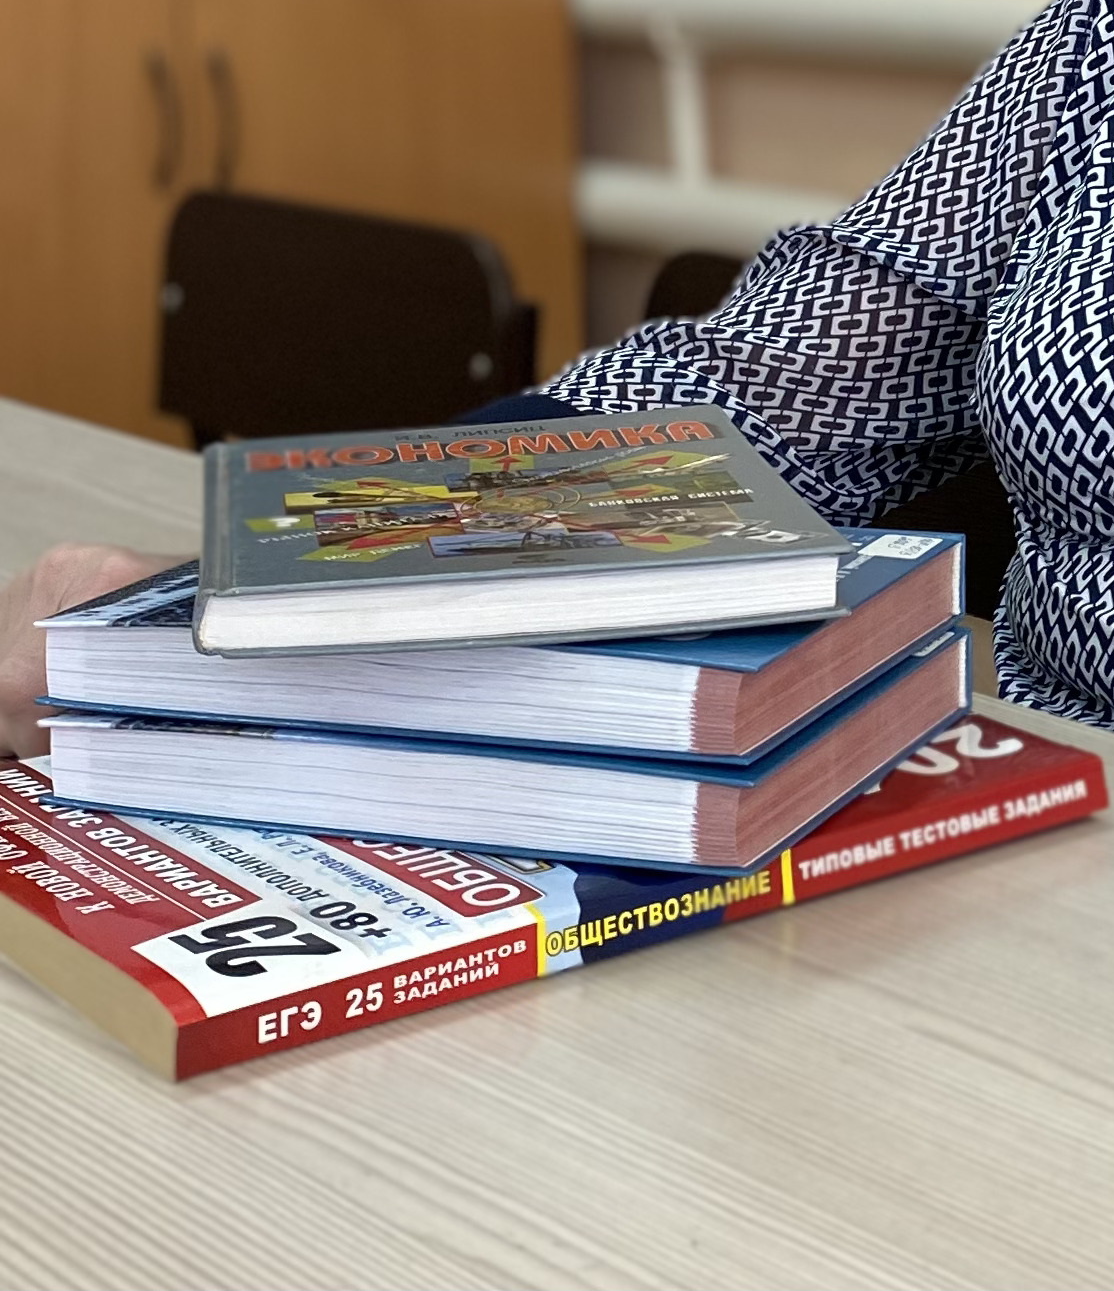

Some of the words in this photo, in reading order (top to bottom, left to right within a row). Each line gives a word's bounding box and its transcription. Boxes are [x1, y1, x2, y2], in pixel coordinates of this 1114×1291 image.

[244, 420, 714, 473] ЭКОНОМИКА
[452, 425, 547, 438] ЛИПСИЦ
[799, 838, 896, 880] ТИПОВЫЕ
[899, 806, 1001, 850] ТЕСТОВЫЕ
[1004, 780, 1089, 821] ЗАДАНИЯ
[2, 821, 161, 905] ДЕМОНСТРАЦИОННОЙ
[6, 860, 94, 902] НОВОЙ
[86, 827, 243, 908] ВАРИАНТОВ
[169, 823, 330, 902] ДОПОЛНИТЕЛЬНЫХ
[75, 900, 115, 915] К
[309, 901, 392, 939] +80
[401, 902, 430, 920] Ю.
[425, 914, 451, 928] А.
[546, 870, 771, 956] ОБЩЕСТВОЗНАНИЕ
[168, 916, 341, 978] 25
[393, 939, 527, 990] ВАРИАНТОВ
[393, 962, 500, 1005] ЗАДАНИЙ
[257, 1000, 323, 1044] ЕГЭ
[344, 982, 384, 1019] 25
